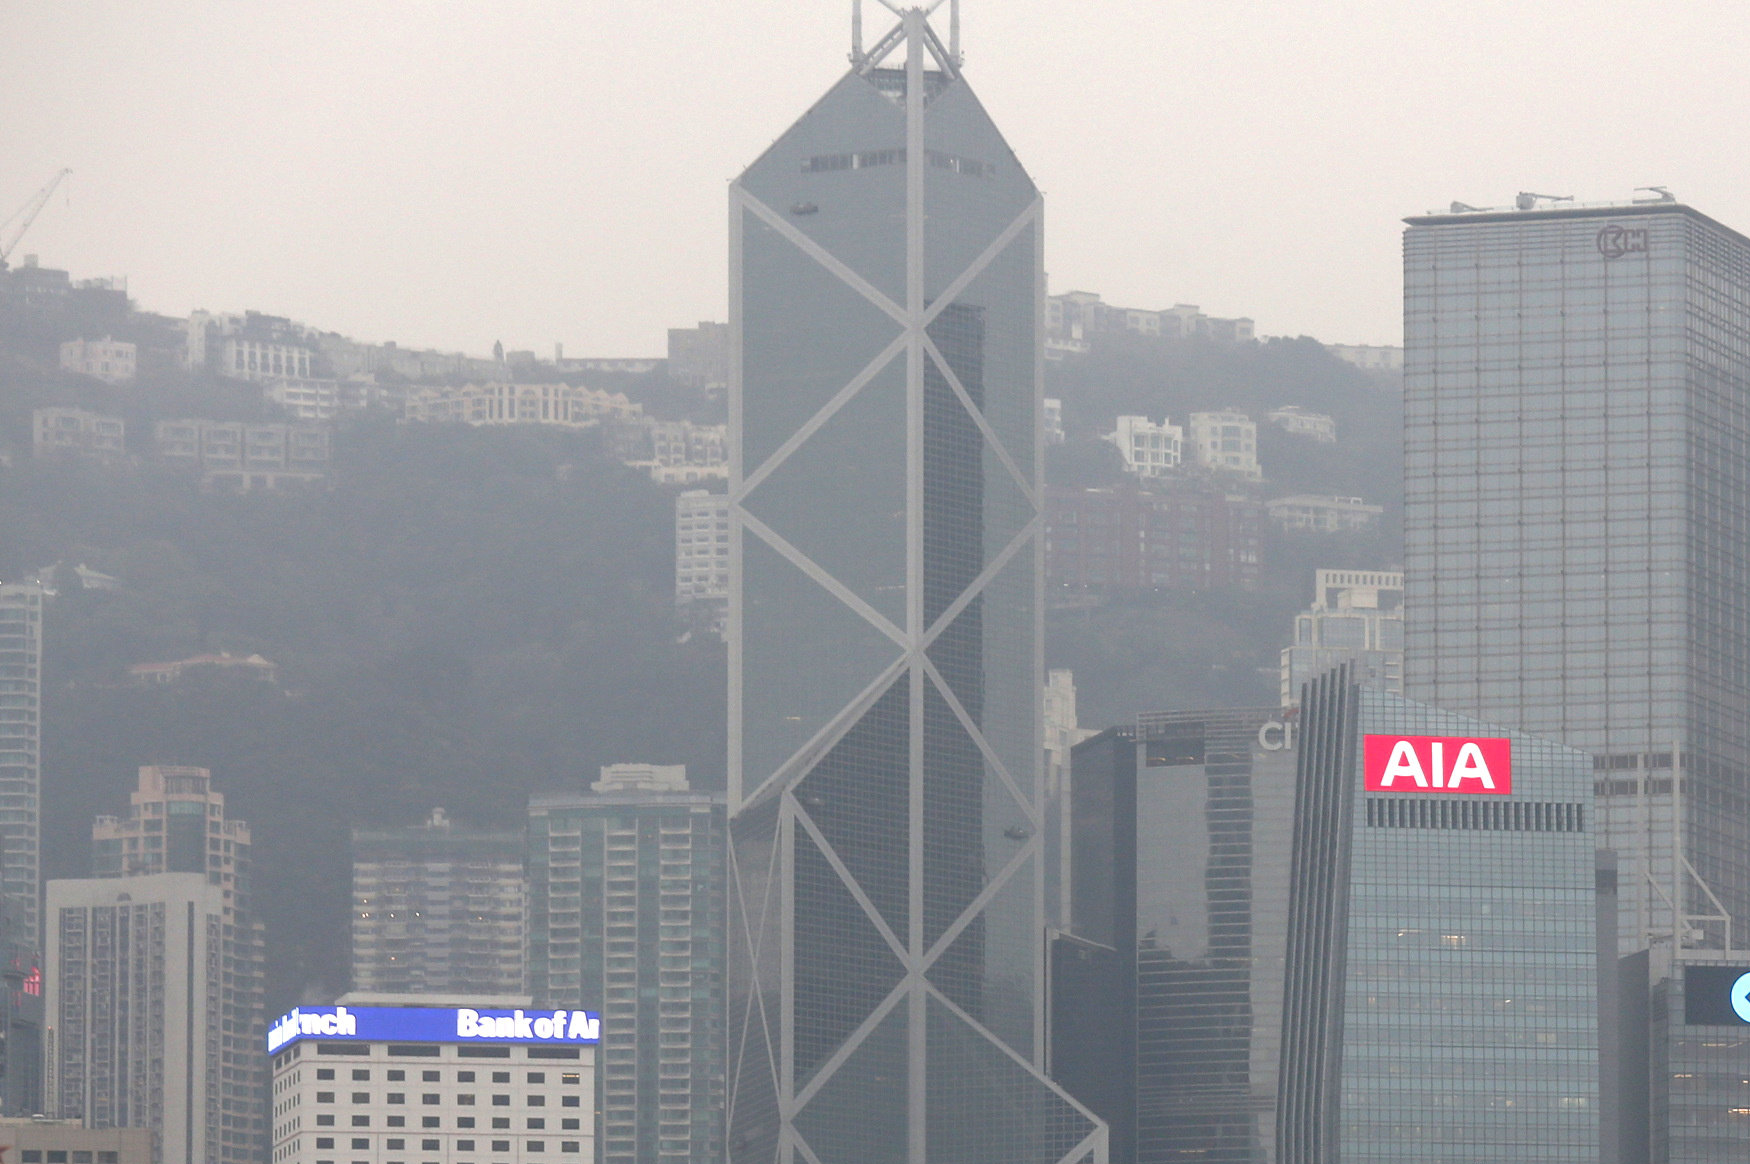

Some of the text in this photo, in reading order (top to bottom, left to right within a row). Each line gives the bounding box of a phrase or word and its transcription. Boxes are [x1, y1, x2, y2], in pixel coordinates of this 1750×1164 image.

[1380, 740, 1496, 789] AIA
[457, 1008, 533, 1038] Bank
[534, 1009, 567, 1039] of
